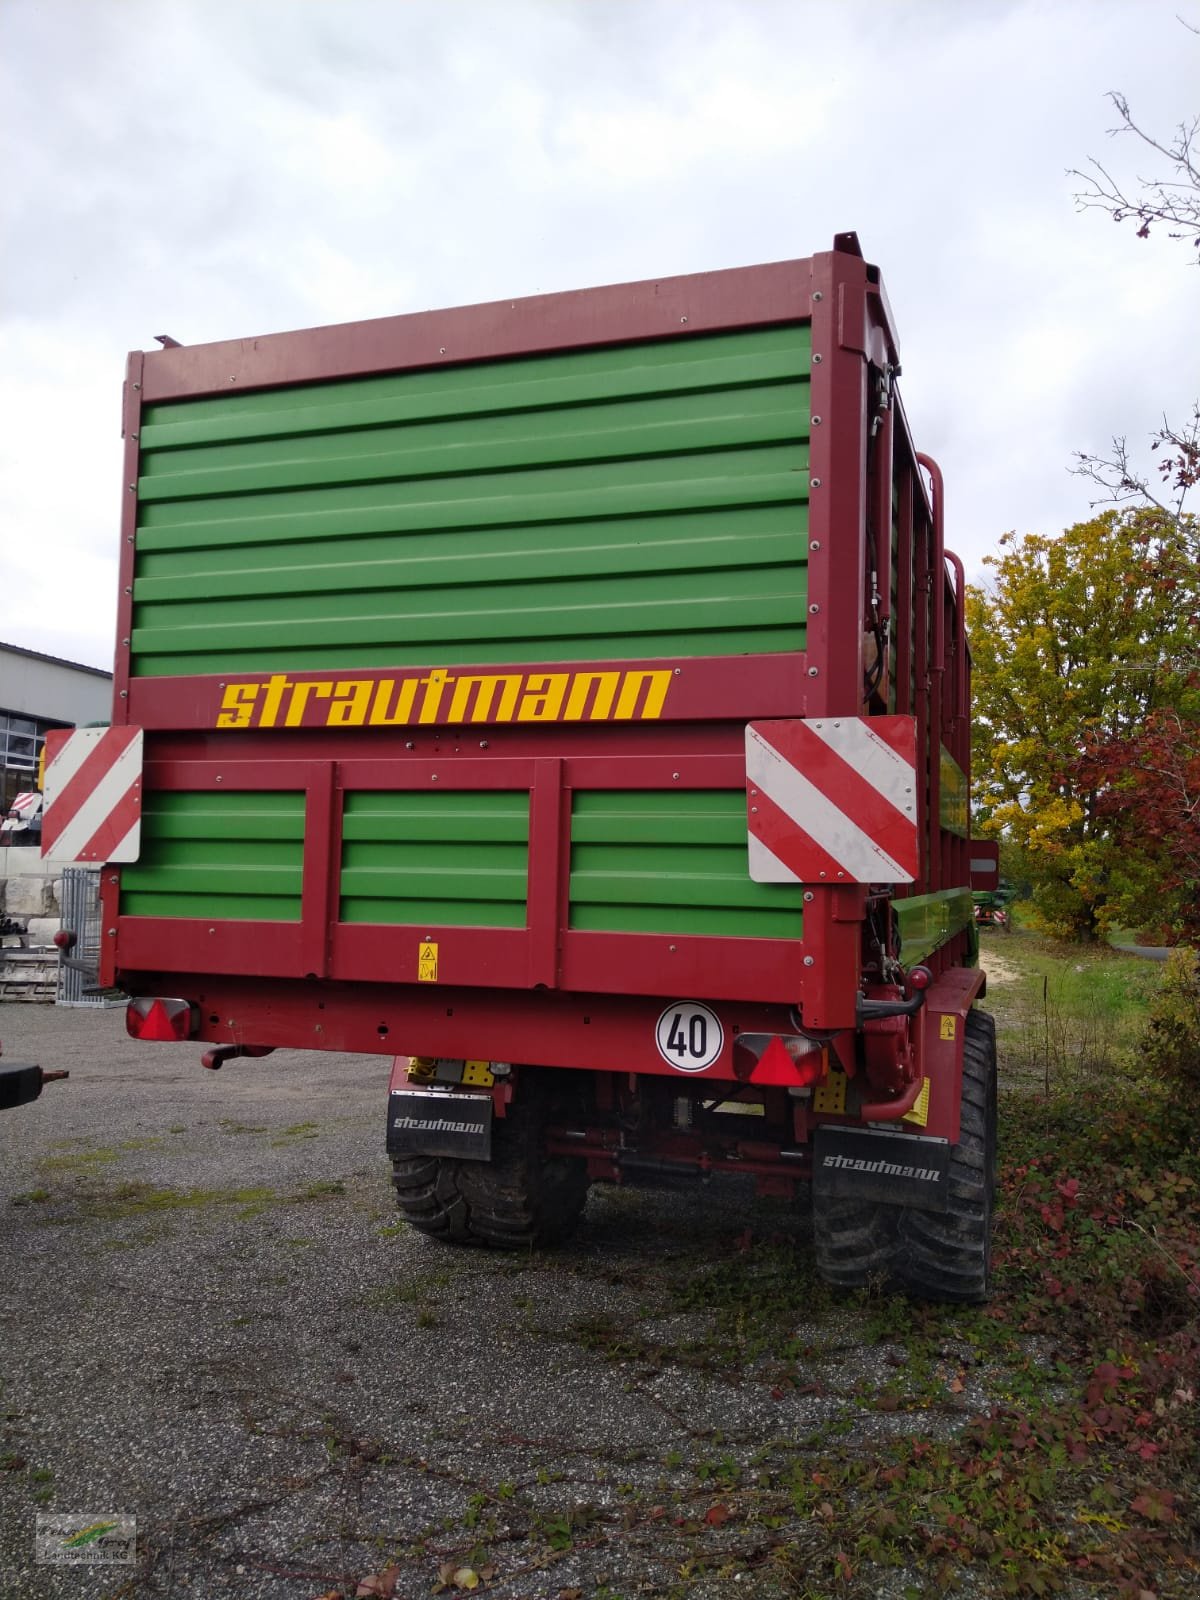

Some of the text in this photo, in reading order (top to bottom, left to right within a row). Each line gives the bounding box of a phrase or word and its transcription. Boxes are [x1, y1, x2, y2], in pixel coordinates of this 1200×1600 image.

[216, 669, 673, 728] strautmann
[667, 1013, 706, 1058] 40
[393, 1117, 485, 1134] strautmann
[823, 1155, 942, 1182] strautmann
